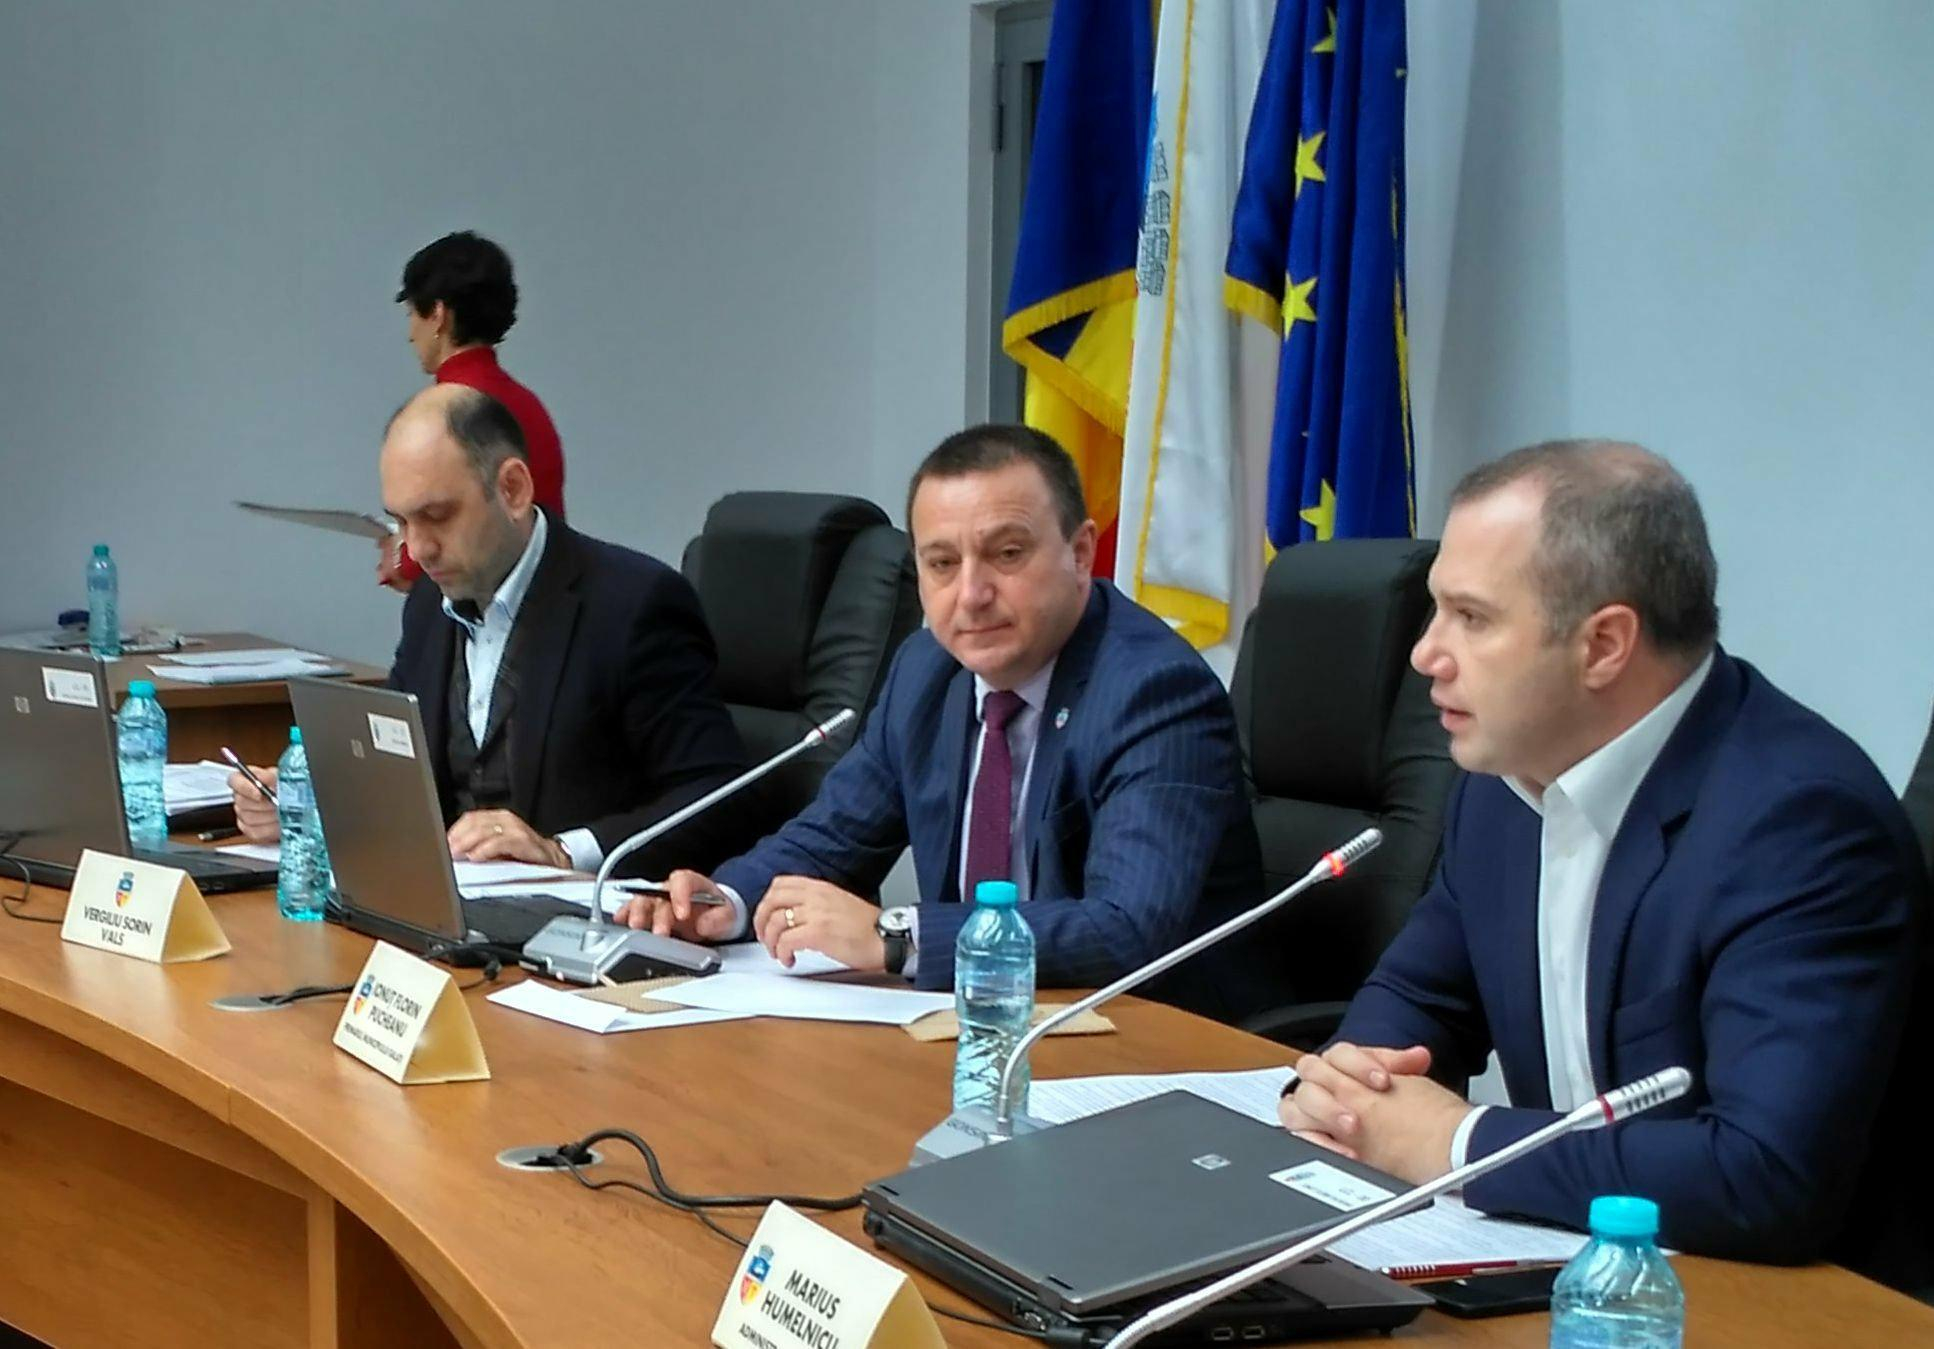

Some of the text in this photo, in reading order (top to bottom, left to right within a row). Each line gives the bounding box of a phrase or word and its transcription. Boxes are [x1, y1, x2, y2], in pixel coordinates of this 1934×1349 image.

[84, 906, 152, 935] VERGILIU SORIN
[101, 928, 125, 946] VALS
[785, 1269, 840, 1319] MARIUS
[739, 1323, 778, 1349] ADMINIST
